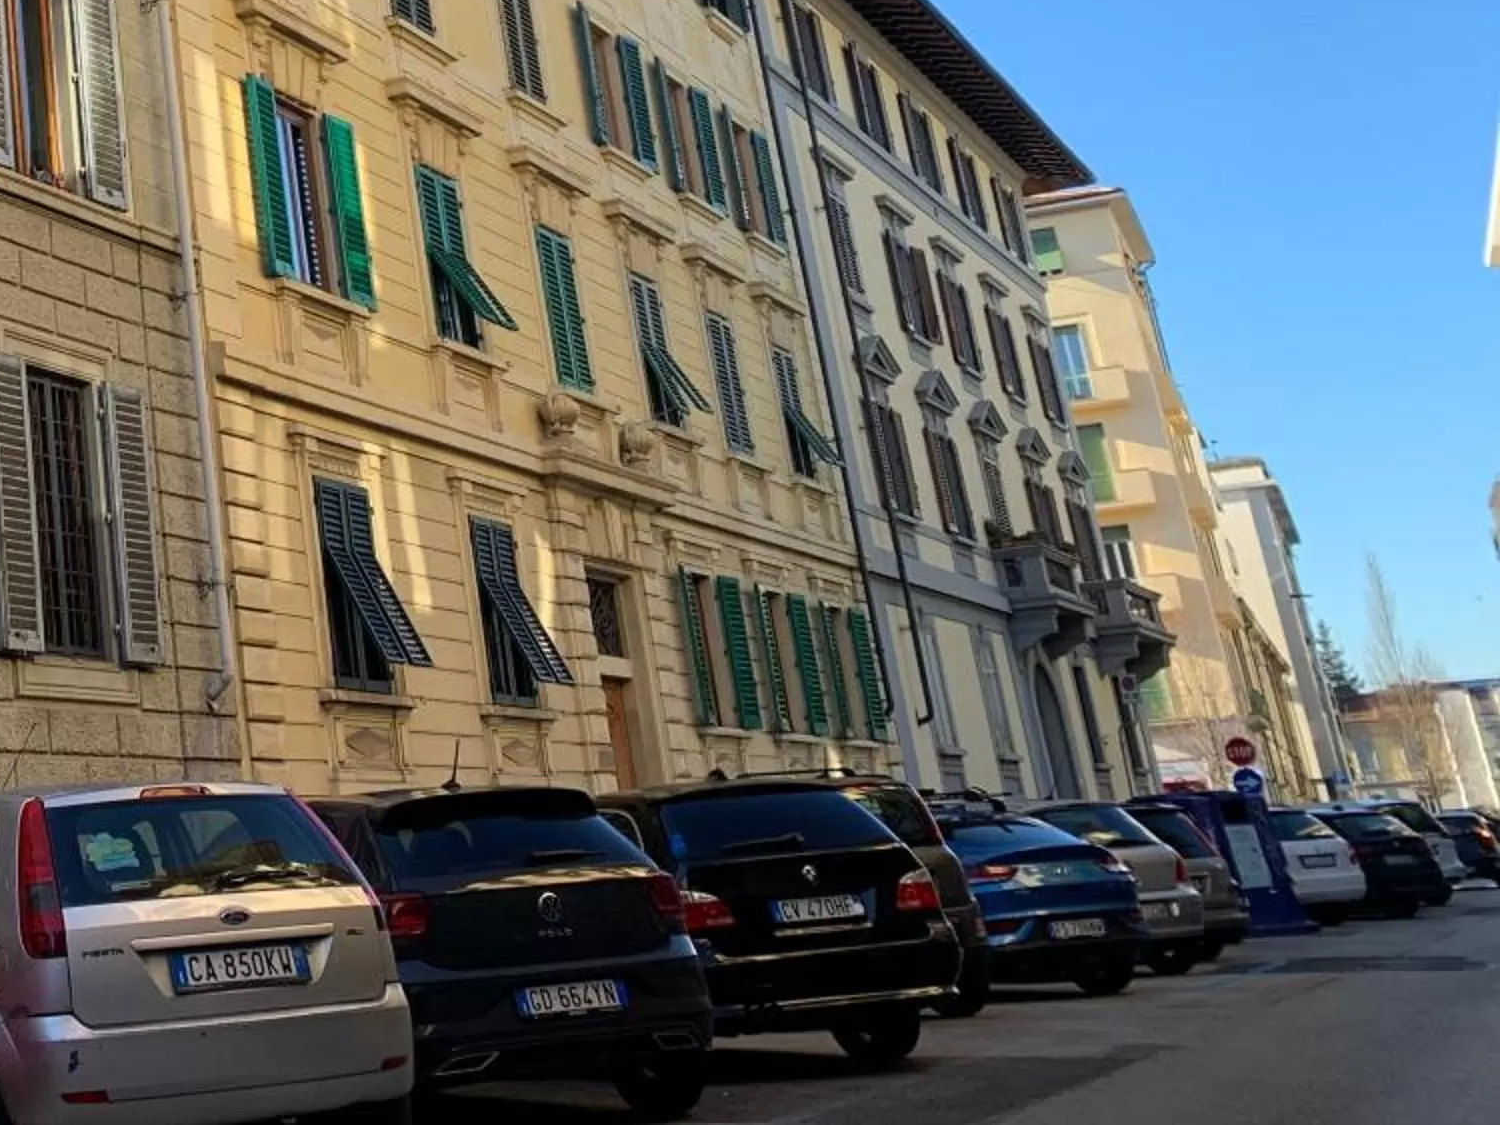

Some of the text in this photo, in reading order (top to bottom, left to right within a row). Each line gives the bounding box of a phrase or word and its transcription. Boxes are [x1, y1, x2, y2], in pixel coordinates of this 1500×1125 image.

[1227, 746, 1252, 759] STOP
[189, 948, 293, 982] CA 850KW
